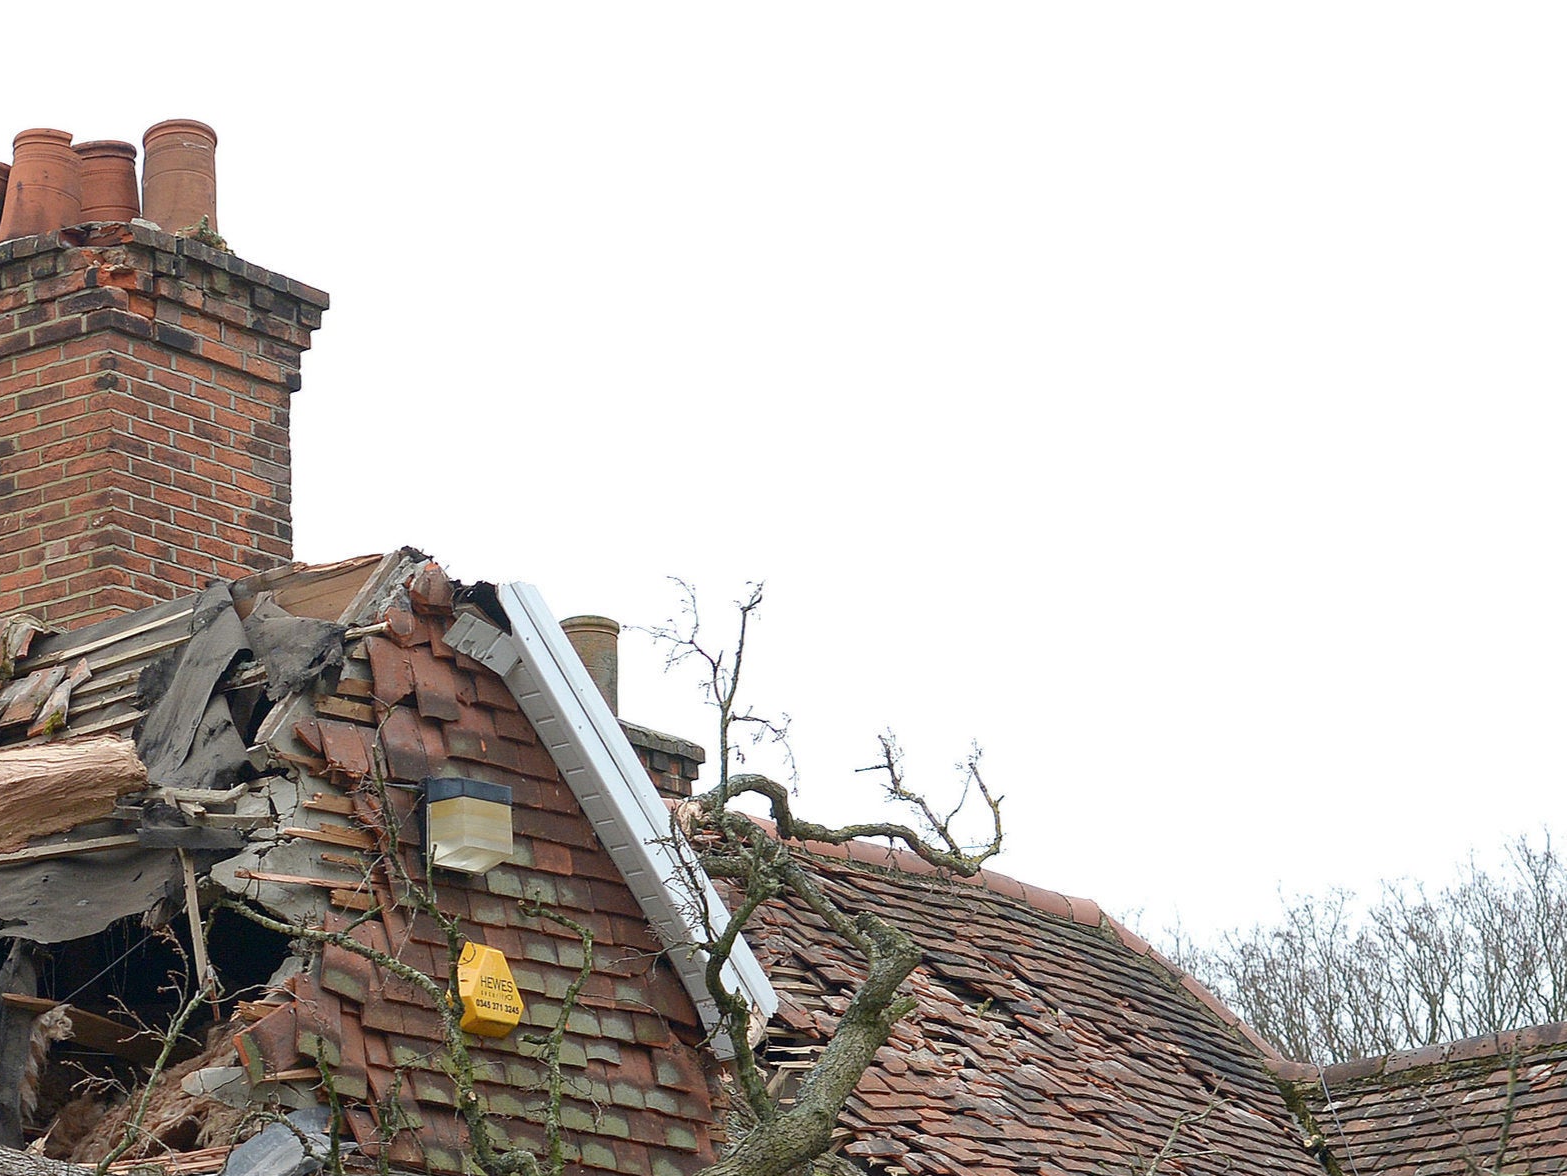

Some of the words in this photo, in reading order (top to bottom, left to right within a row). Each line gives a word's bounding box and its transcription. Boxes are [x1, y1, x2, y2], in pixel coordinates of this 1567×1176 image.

[480, 975, 513, 993] HEWES
[476, 998, 491, 1009] 0345
[492, 1002, 503, 1012] 371
[504, 1004, 519, 1015] 3245
